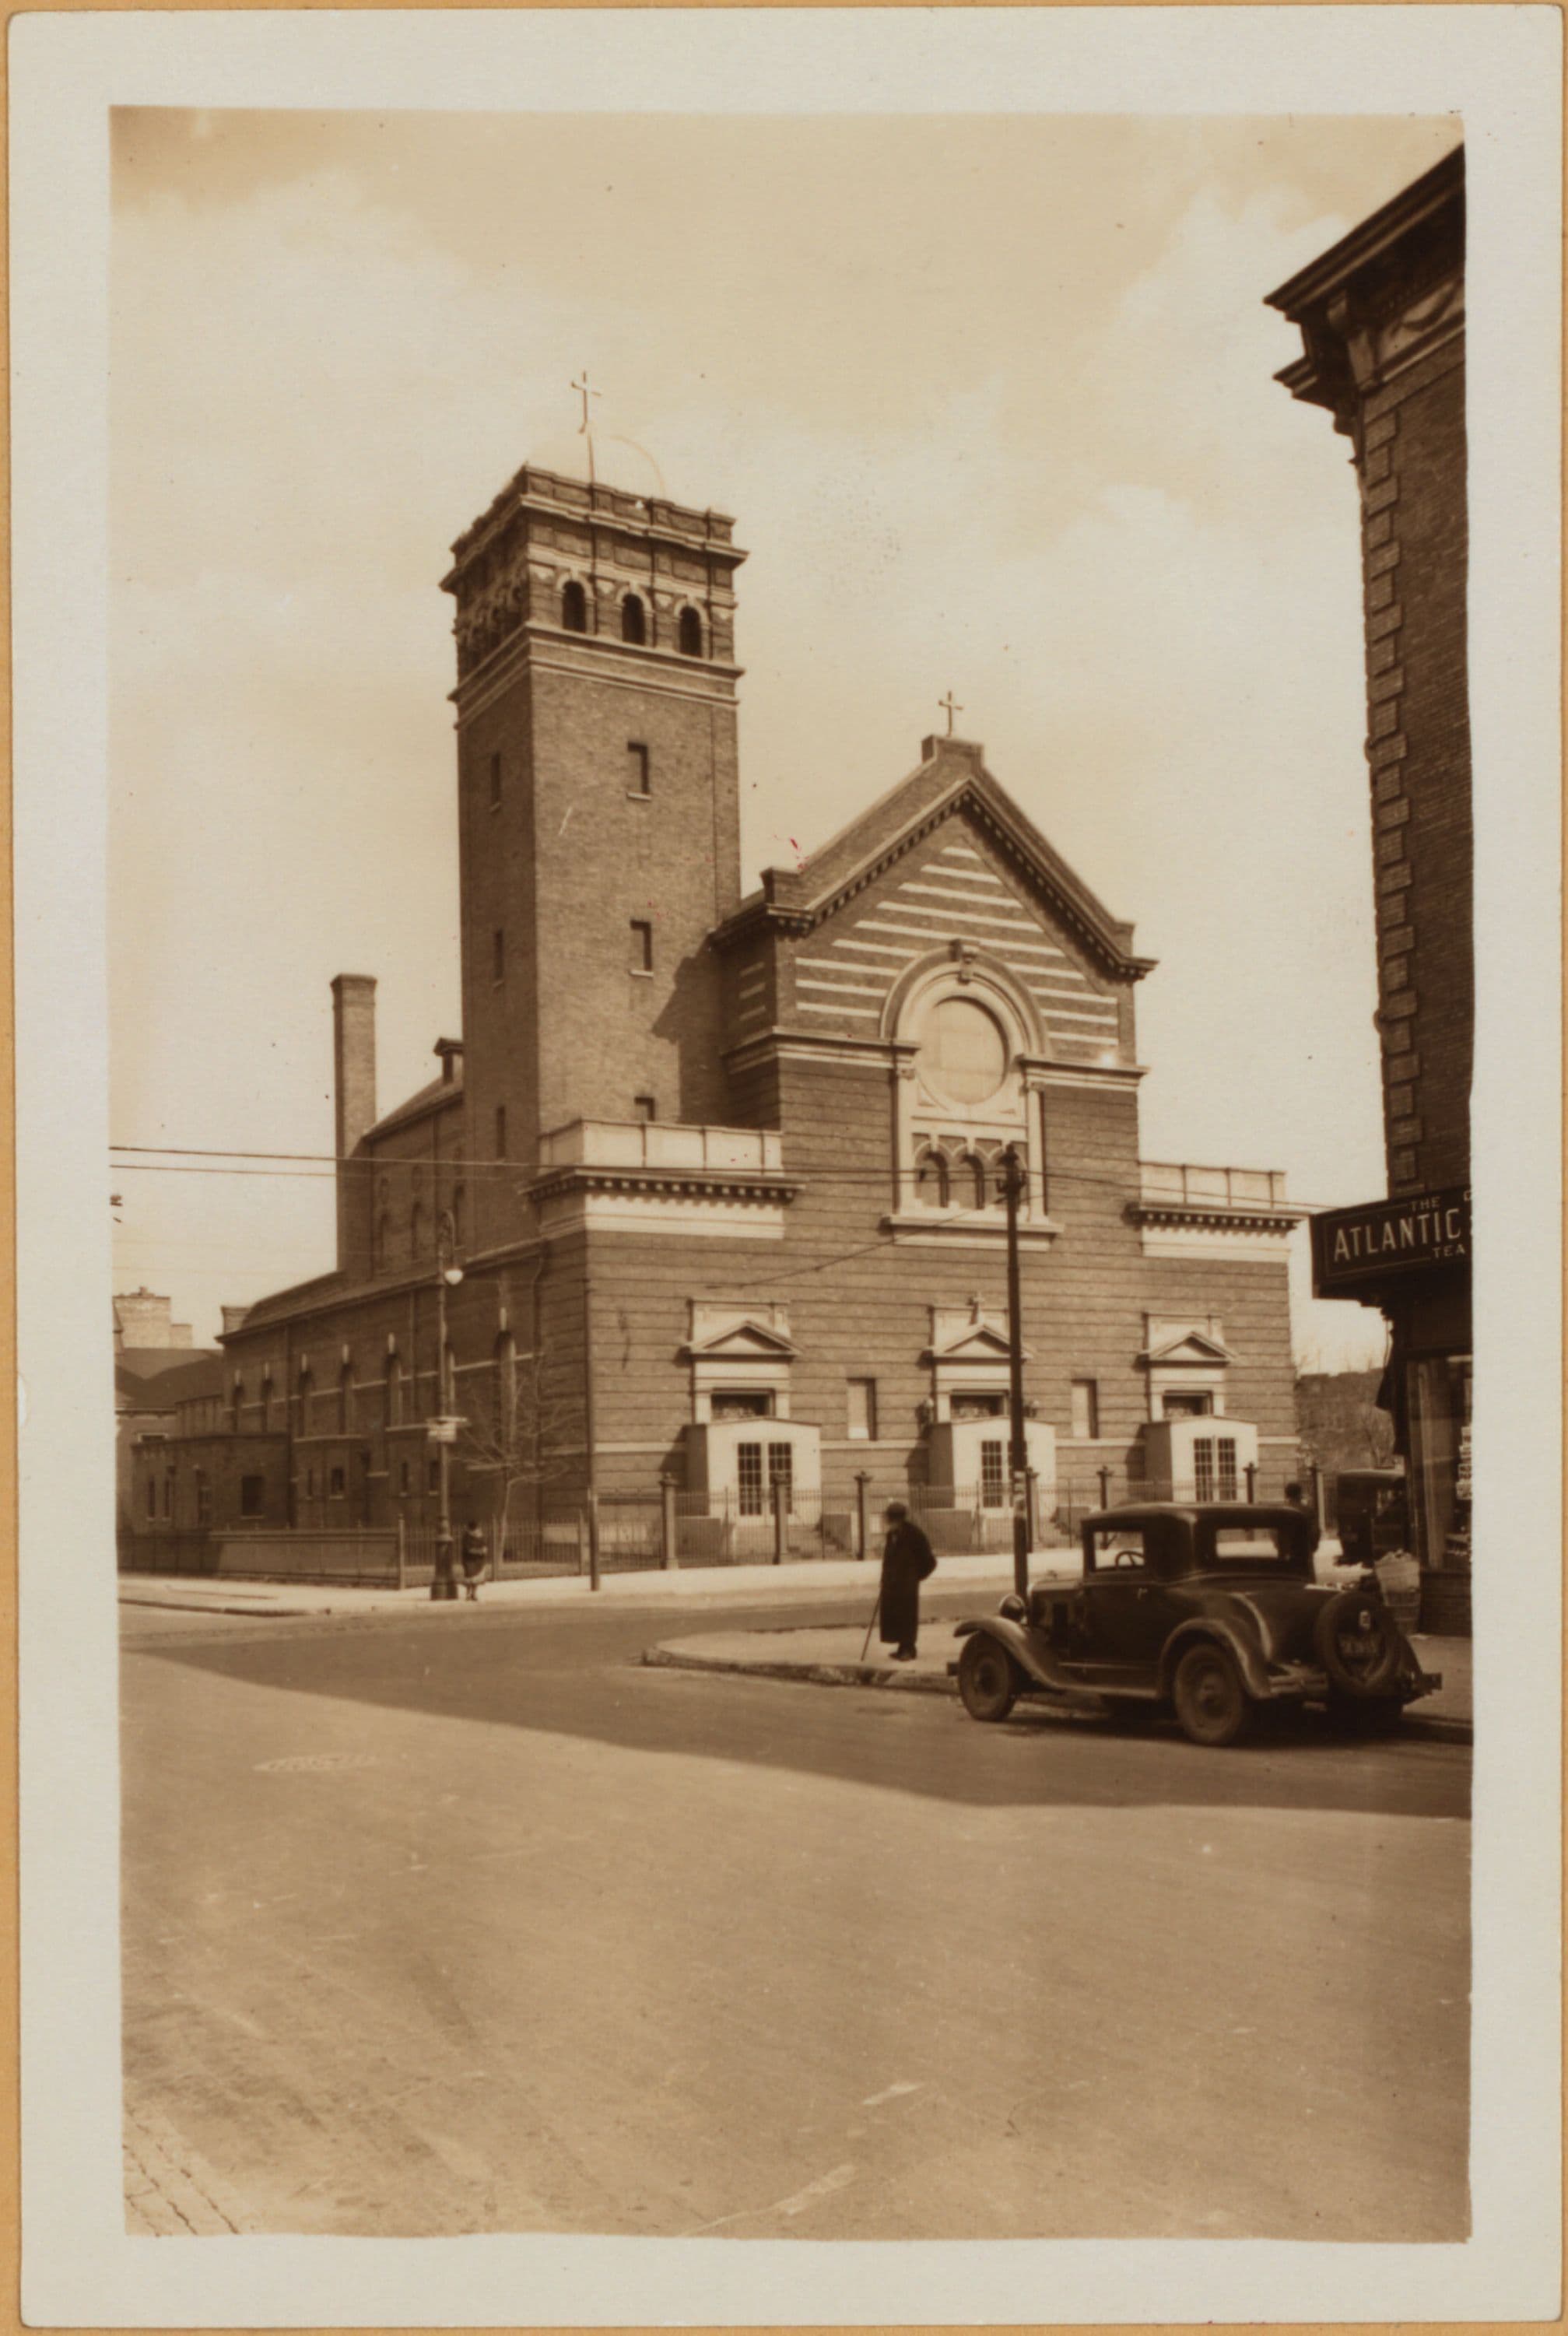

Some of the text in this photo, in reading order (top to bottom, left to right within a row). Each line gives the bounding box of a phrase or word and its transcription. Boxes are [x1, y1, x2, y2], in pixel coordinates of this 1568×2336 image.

[1410, 1196, 1440, 1212] THE
[1333, 1208, 1461, 1262] ATLANTIC
[1431, 1243, 1466, 1258] TEA
